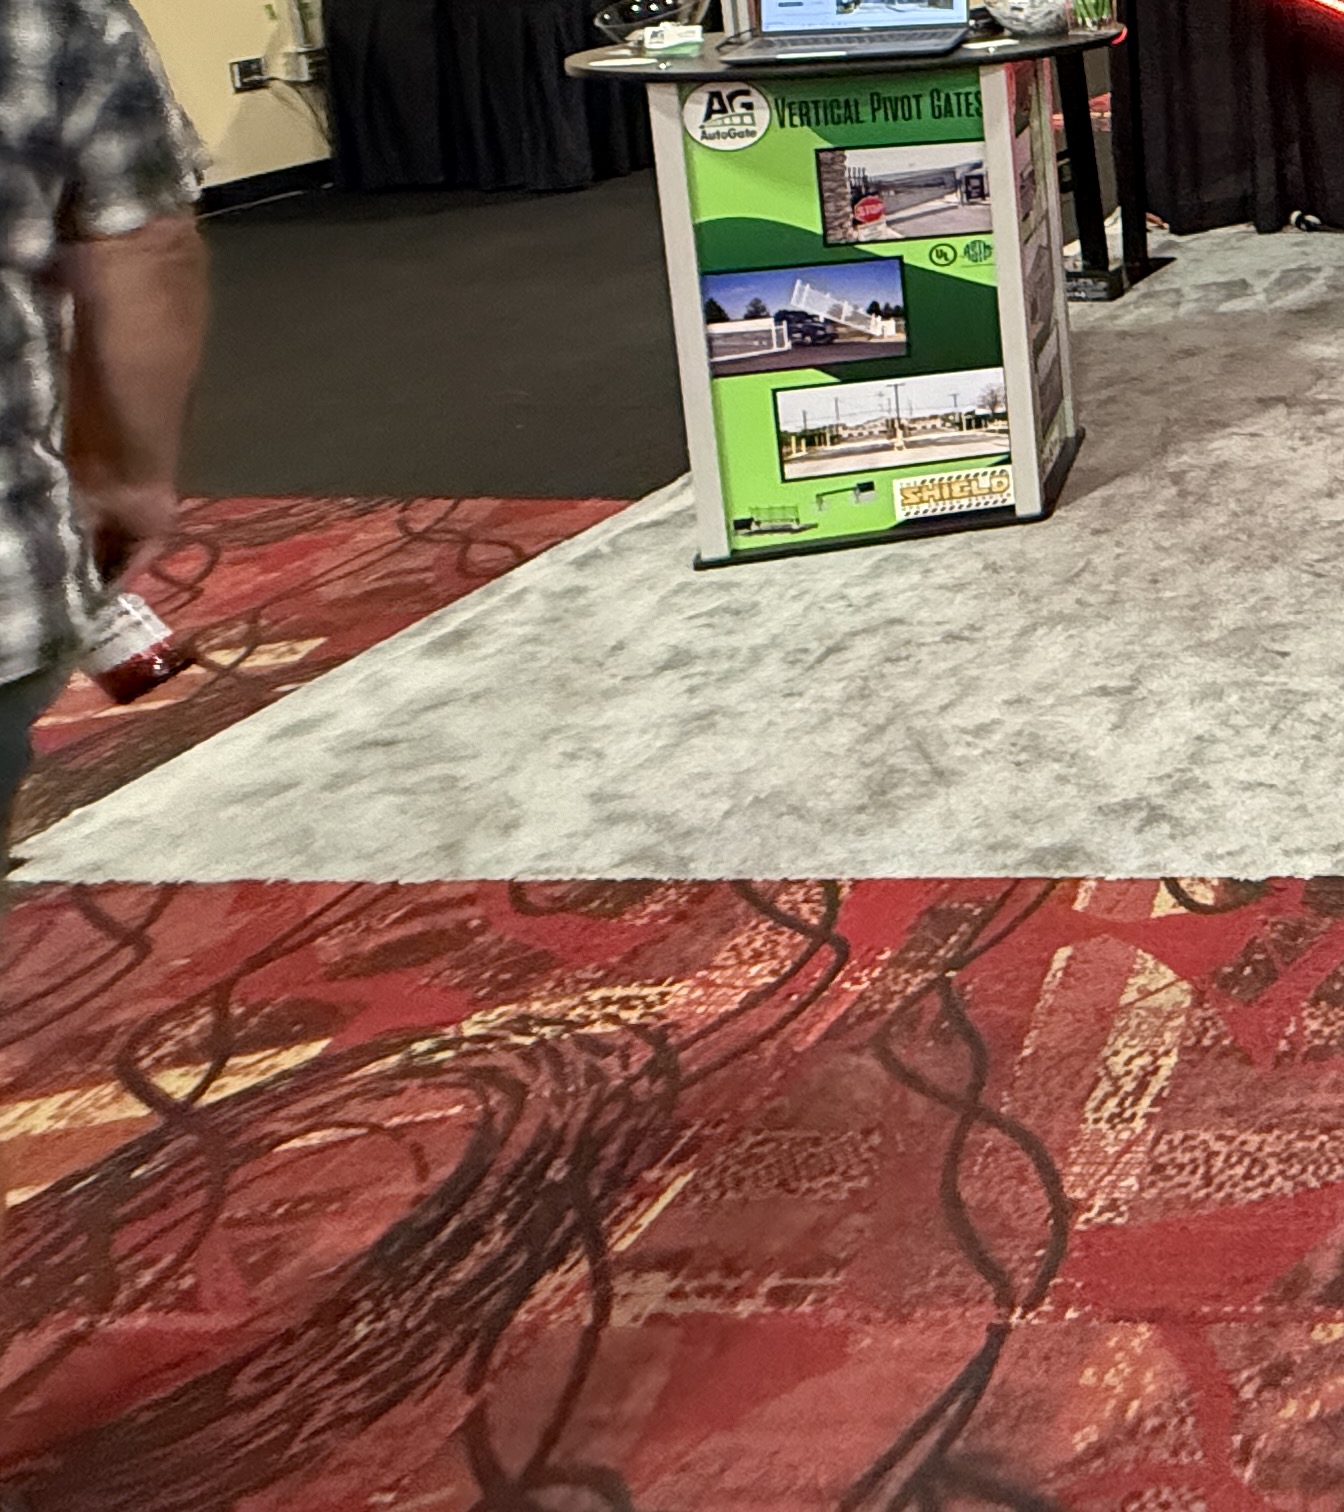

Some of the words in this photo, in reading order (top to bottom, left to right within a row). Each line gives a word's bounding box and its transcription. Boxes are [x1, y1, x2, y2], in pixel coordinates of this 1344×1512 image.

[703, 89, 753, 122] AG
[774, 97, 863, 129] VERTICAL
[871, 91, 922, 122] PIVOT
[931, 88, 982, 119] GATES
[701, 128, 757, 141] AutoGate
[901, 473, 1010, 506] SHIELD
